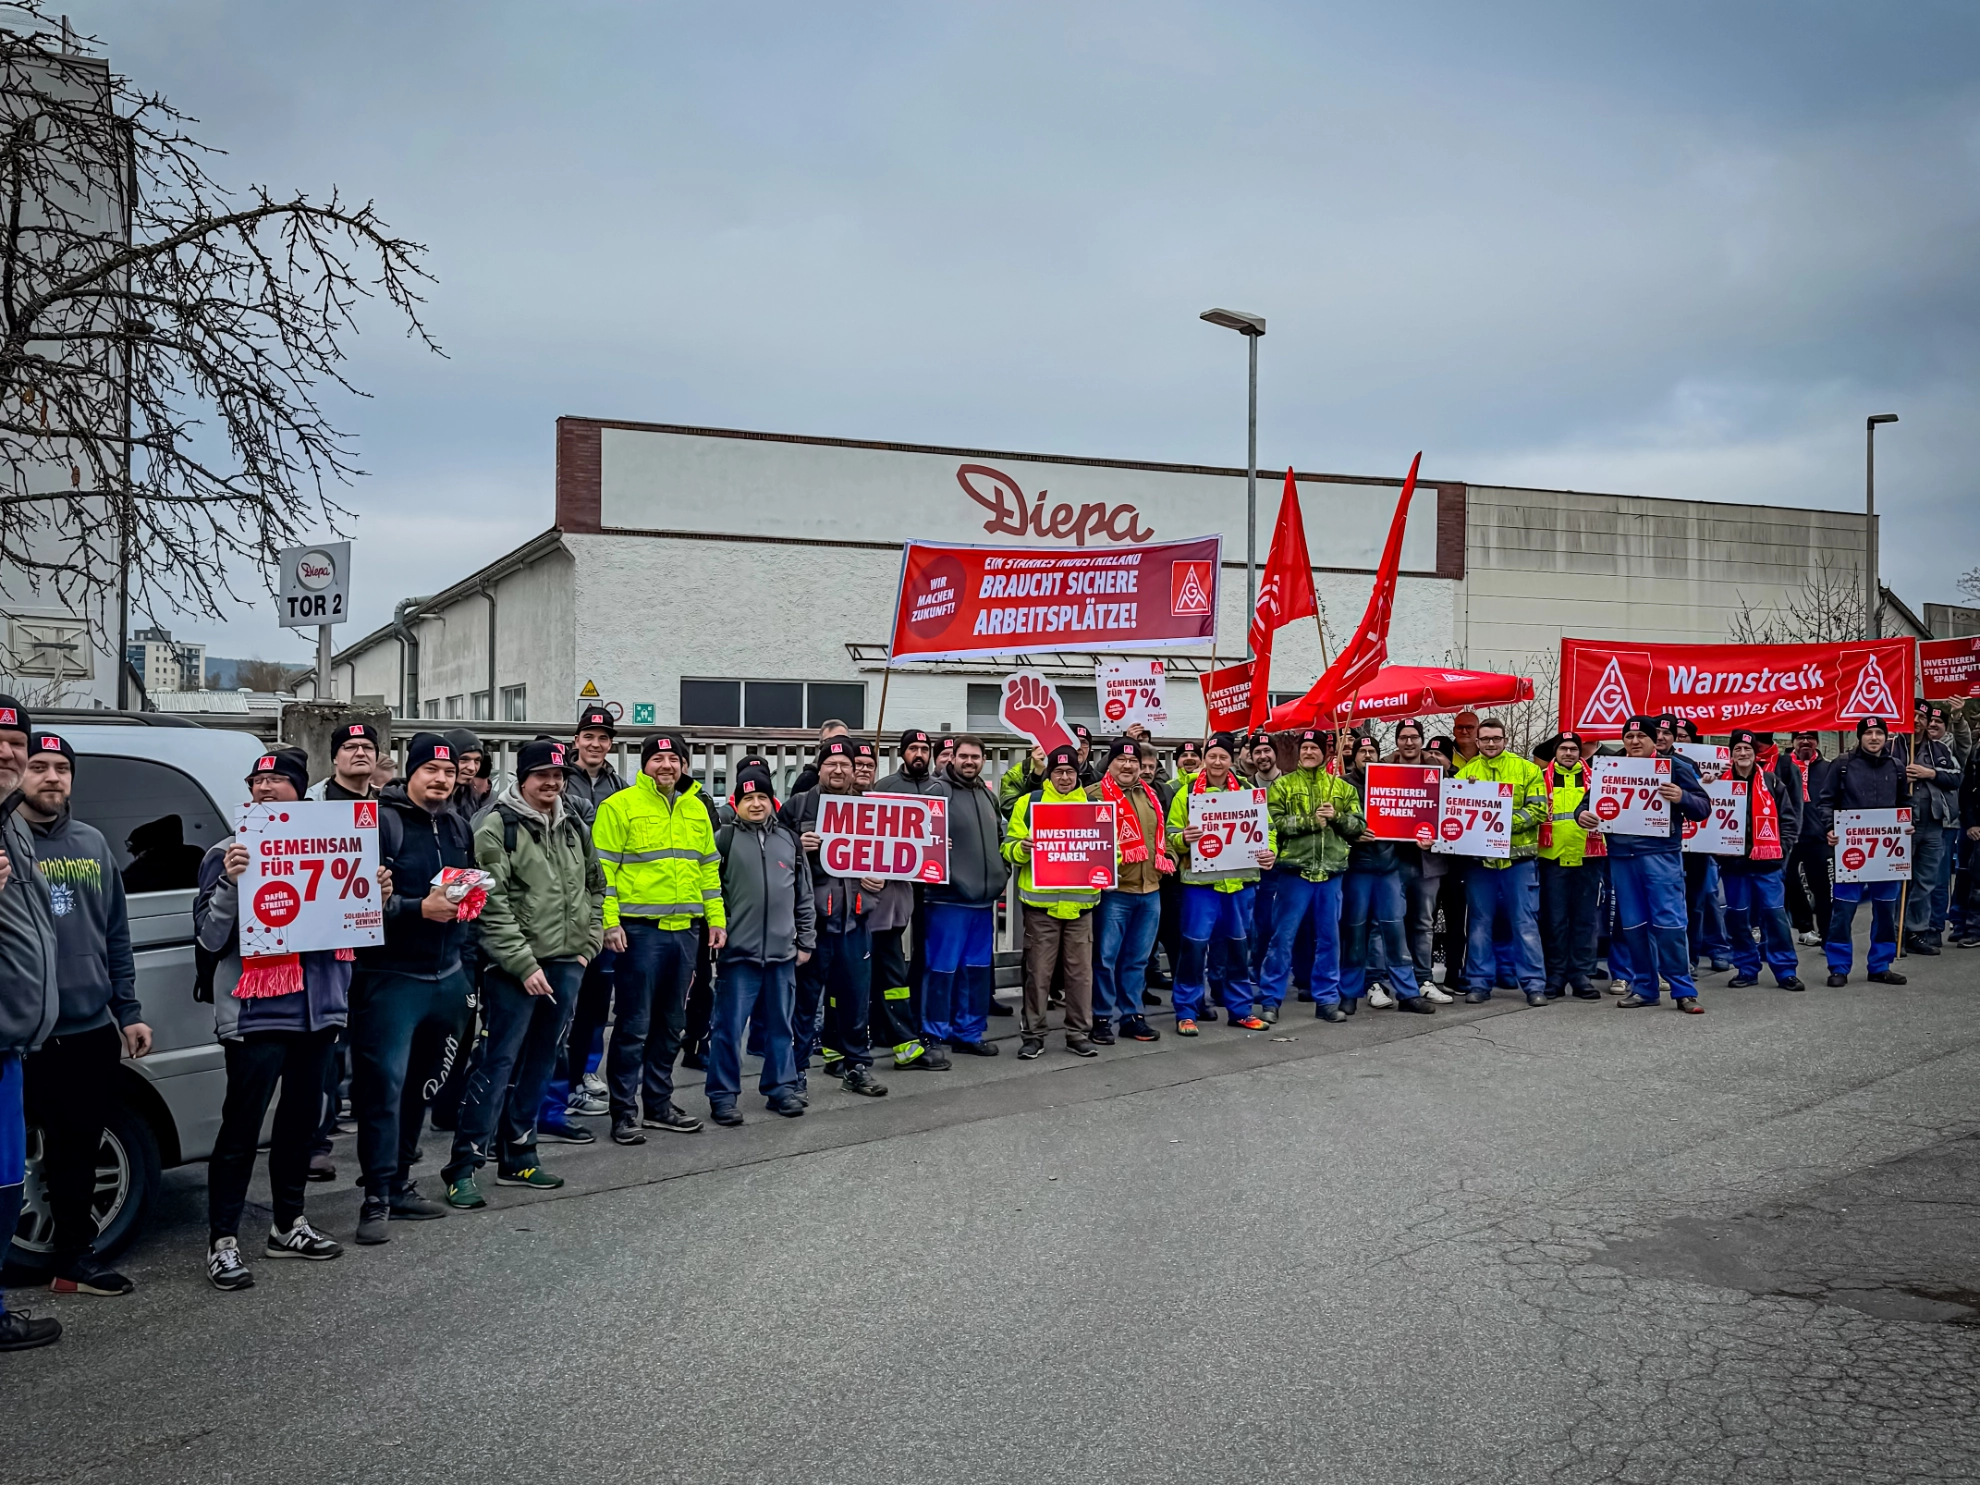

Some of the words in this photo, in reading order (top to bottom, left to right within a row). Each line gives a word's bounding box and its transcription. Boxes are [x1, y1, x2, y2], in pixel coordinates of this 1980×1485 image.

[957, 464, 1154, 546] Diepa
[984, 557, 1007, 570] EIN
[301, 563, 331, 578] Diepa
[931, 576, 947, 590] WIR
[979, 572, 1064, 599] BRAUCHT
[1066, 570, 1139, 595] SICHERE
[917, 588, 954, 607] MACHEN
[287, 595, 326, 618] TOR
[332, 593, 342, 614] 2
[911, 602, 955, 622] ZUKUNFT!
[973, 597, 1137, 635] ARBEITSPLÄTZE!
[1923, 655, 1975, 667] INVESTIEREN
[1924, 667, 1948, 675] STATT
[1107, 679, 1156, 688] GEMEINSAM
[1667, 663, 1824, 694] Warnstreik
[1934, 673, 1968, 683] SPAREN.
[1107, 689, 1122, 697] FÜR
[1359, 693, 1408, 709] Metall
[1219, 701, 1249, 716] SPAREN.
[1662, 705, 1715, 719] unser
[1721, 701, 1770, 721] gutes
[1772, 695, 1823, 713] Recht
[1602, 776, 1659, 786] GEMEINSAM
[1370, 787, 1426, 797] INVESTIEREN
[1601, 785, 1617, 794] FÜR
[1370, 798, 1396, 807] STATT
[1398, 799, 1437, 808] KAPUTT-
[1446, 797, 1501, 809] GEMEINSAM
[1202, 809, 1258, 821] GEMEINSAM
[1379, 808, 1416, 817] SPAREN.
[1446, 806, 1462, 816] FÜR
[822, 801, 925, 839] MEHR
[1202, 822, 1219, 832] FÜR
[1846, 827, 1901, 836] GEMEINSAM
[1036, 829, 1099, 839] INVESTIEREN
[260, 837, 362, 856] GEMEINSAM
[1036, 841, 1066, 851] STATT
[1069, 841, 1112, 851] KAPUTT-
[1846, 837, 1863, 845] FÜR
[827, 838, 917, 873] GELD
[1047, 852, 1089, 862] SPAREN.
[261, 857, 294, 876] FÜR
[264, 891, 288, 901] DAFÜR
[261, 899, 294, 910] STREITEN
[270, 908, 287, 917] WIR!
[344, 910, 381, 919] SOLIDARITÄT
